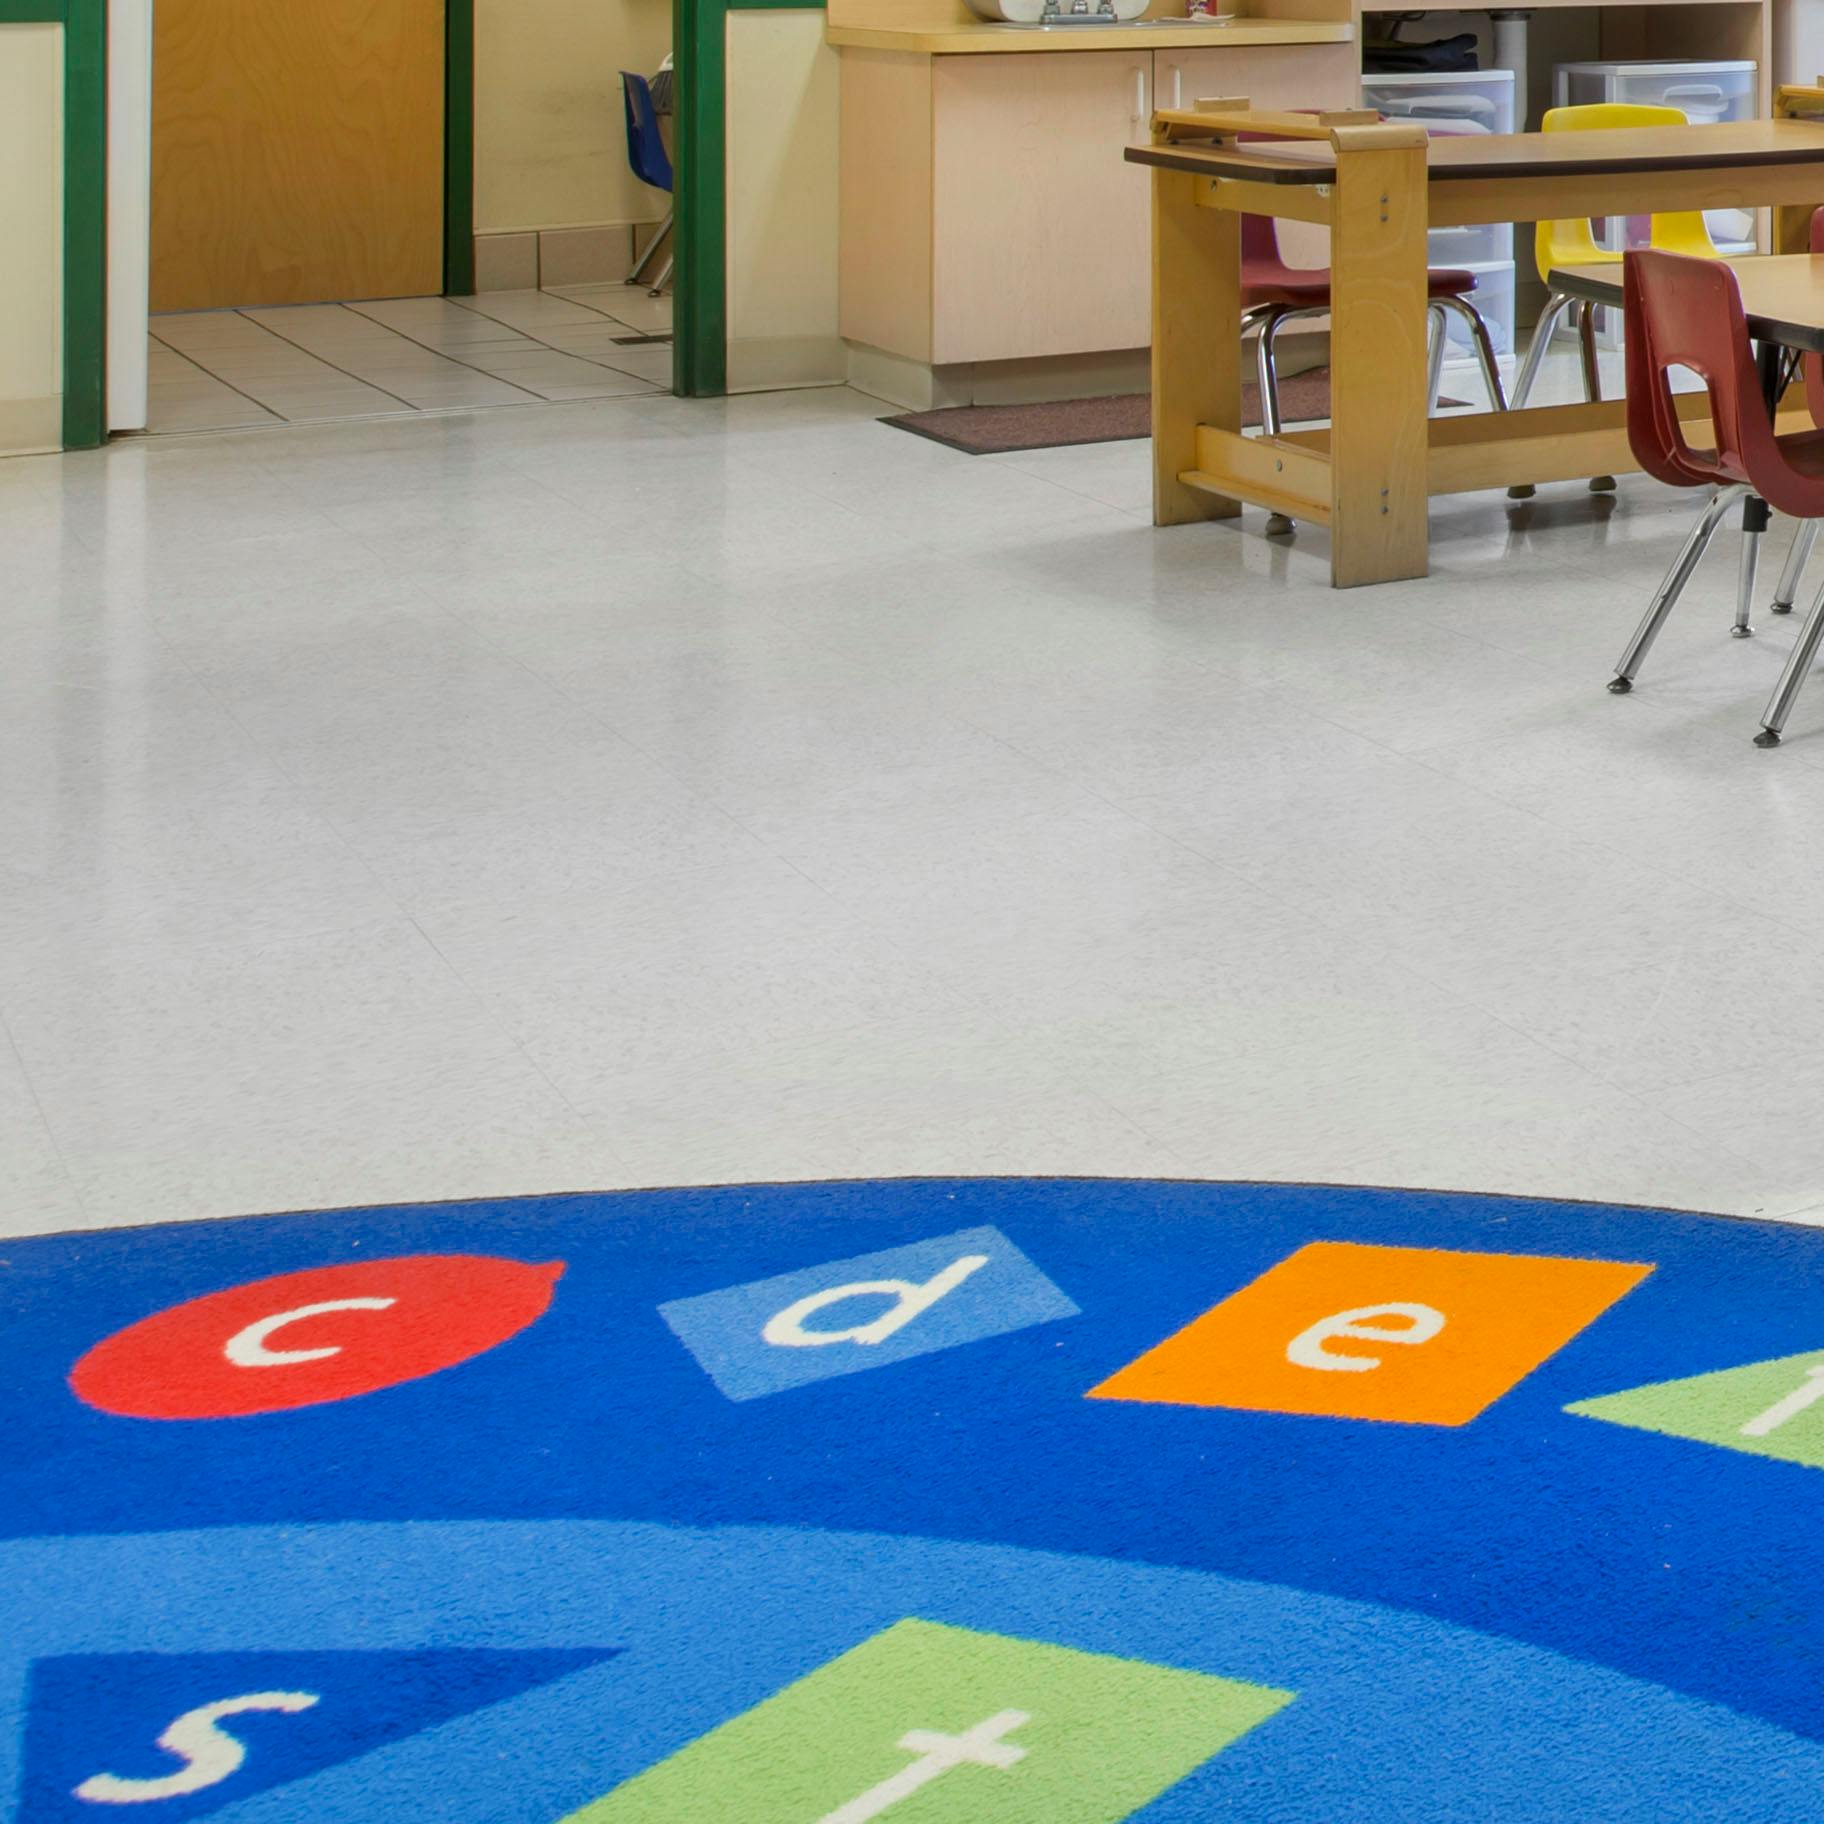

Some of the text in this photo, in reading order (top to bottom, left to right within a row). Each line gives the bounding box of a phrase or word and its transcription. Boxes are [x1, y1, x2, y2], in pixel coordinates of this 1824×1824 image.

[221, 1296, 396, 1370] c
[762, 1254, 989, 1346] d
[1286, 1301, 1447, 1374] e
[73, 1690, 320, 1804] s
[818, 1708, 1031, 1824] t
